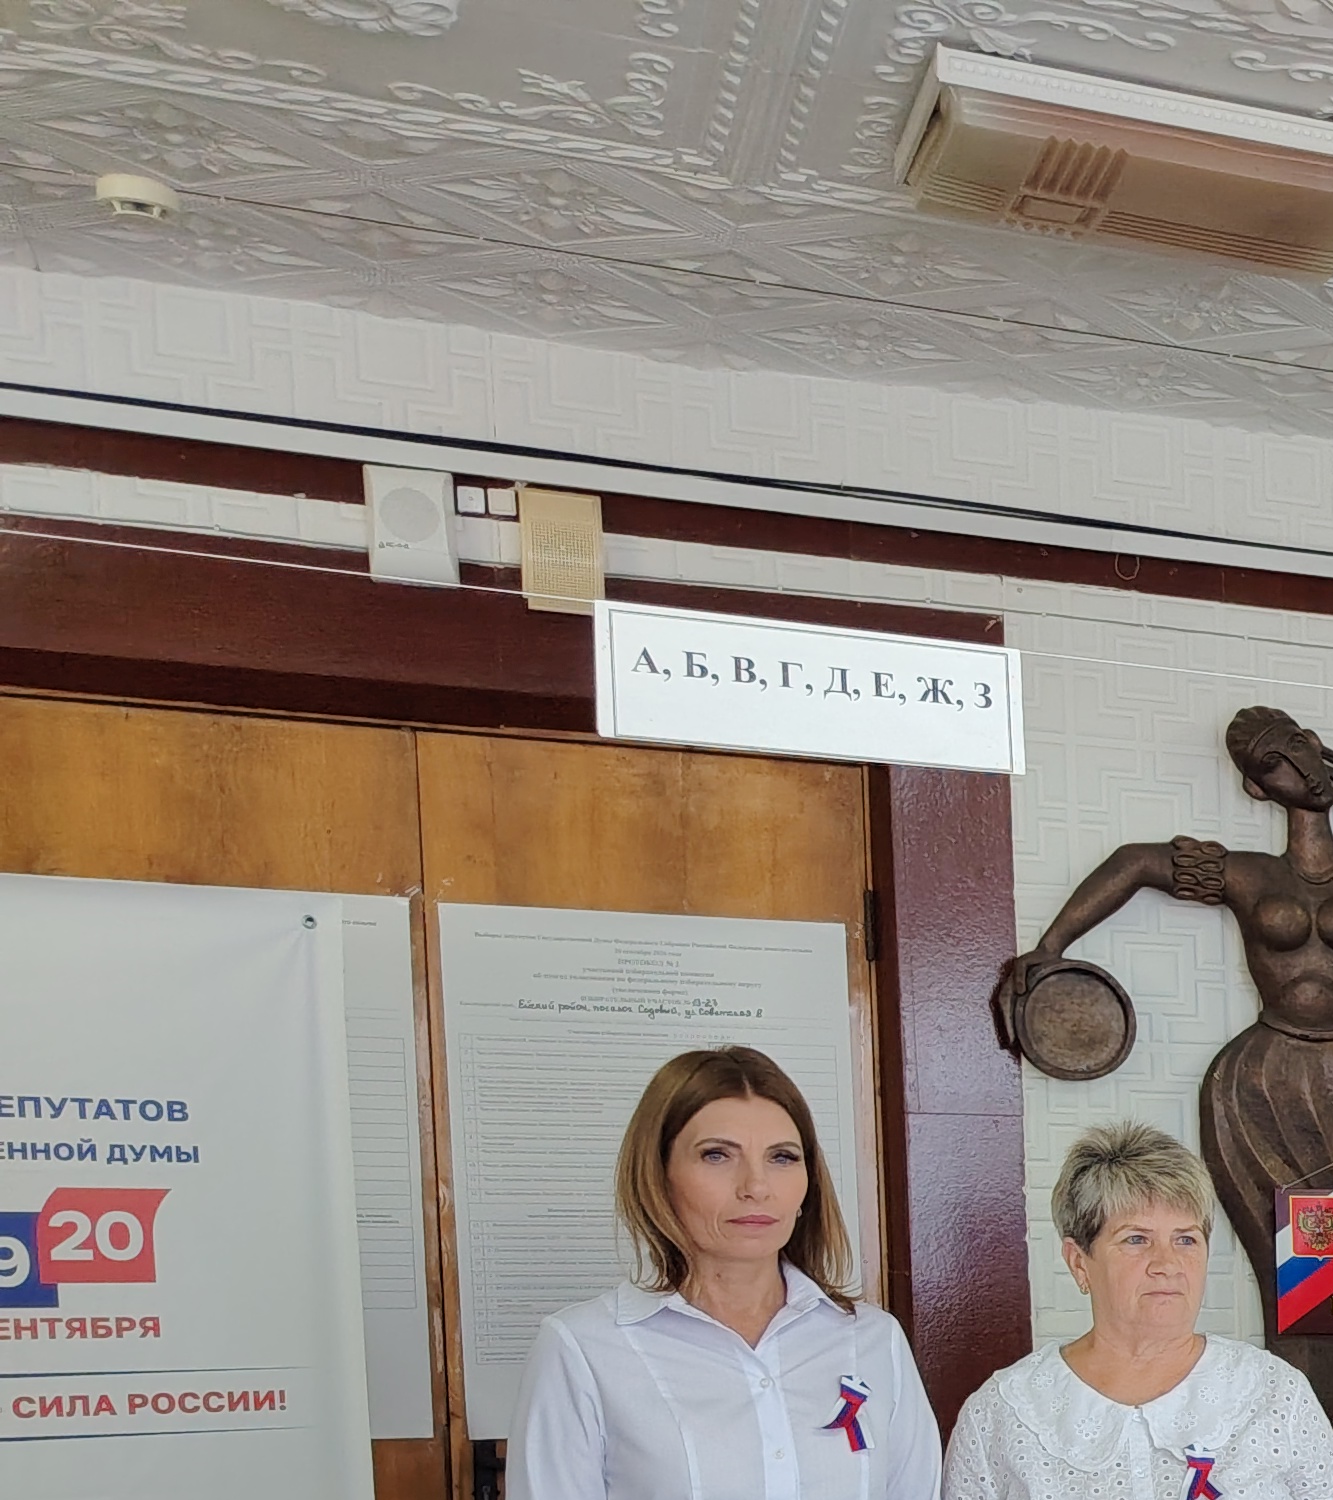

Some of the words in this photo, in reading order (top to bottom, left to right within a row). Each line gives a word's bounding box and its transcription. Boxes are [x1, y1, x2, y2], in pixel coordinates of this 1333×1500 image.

[631, 647, 671, 682] А,
[682, 650, 719, 686] Б,
[731, 655, 768, 692] В,
[778, 661, 814, 697] Г,
[824, 666, 861, 702] Д,
[871, 671, 907, 706] Е,
[916, 676, 964, 712] Ж,
[974, 682, 992, 709] З
[107, 1144, 200, 1165] ДУМЫ
[48, 1210, 144, 1261] 20
[12, 1395, 117, 1418] СИЛА
[127, 1390, 287, 1414] РОССИИ!
